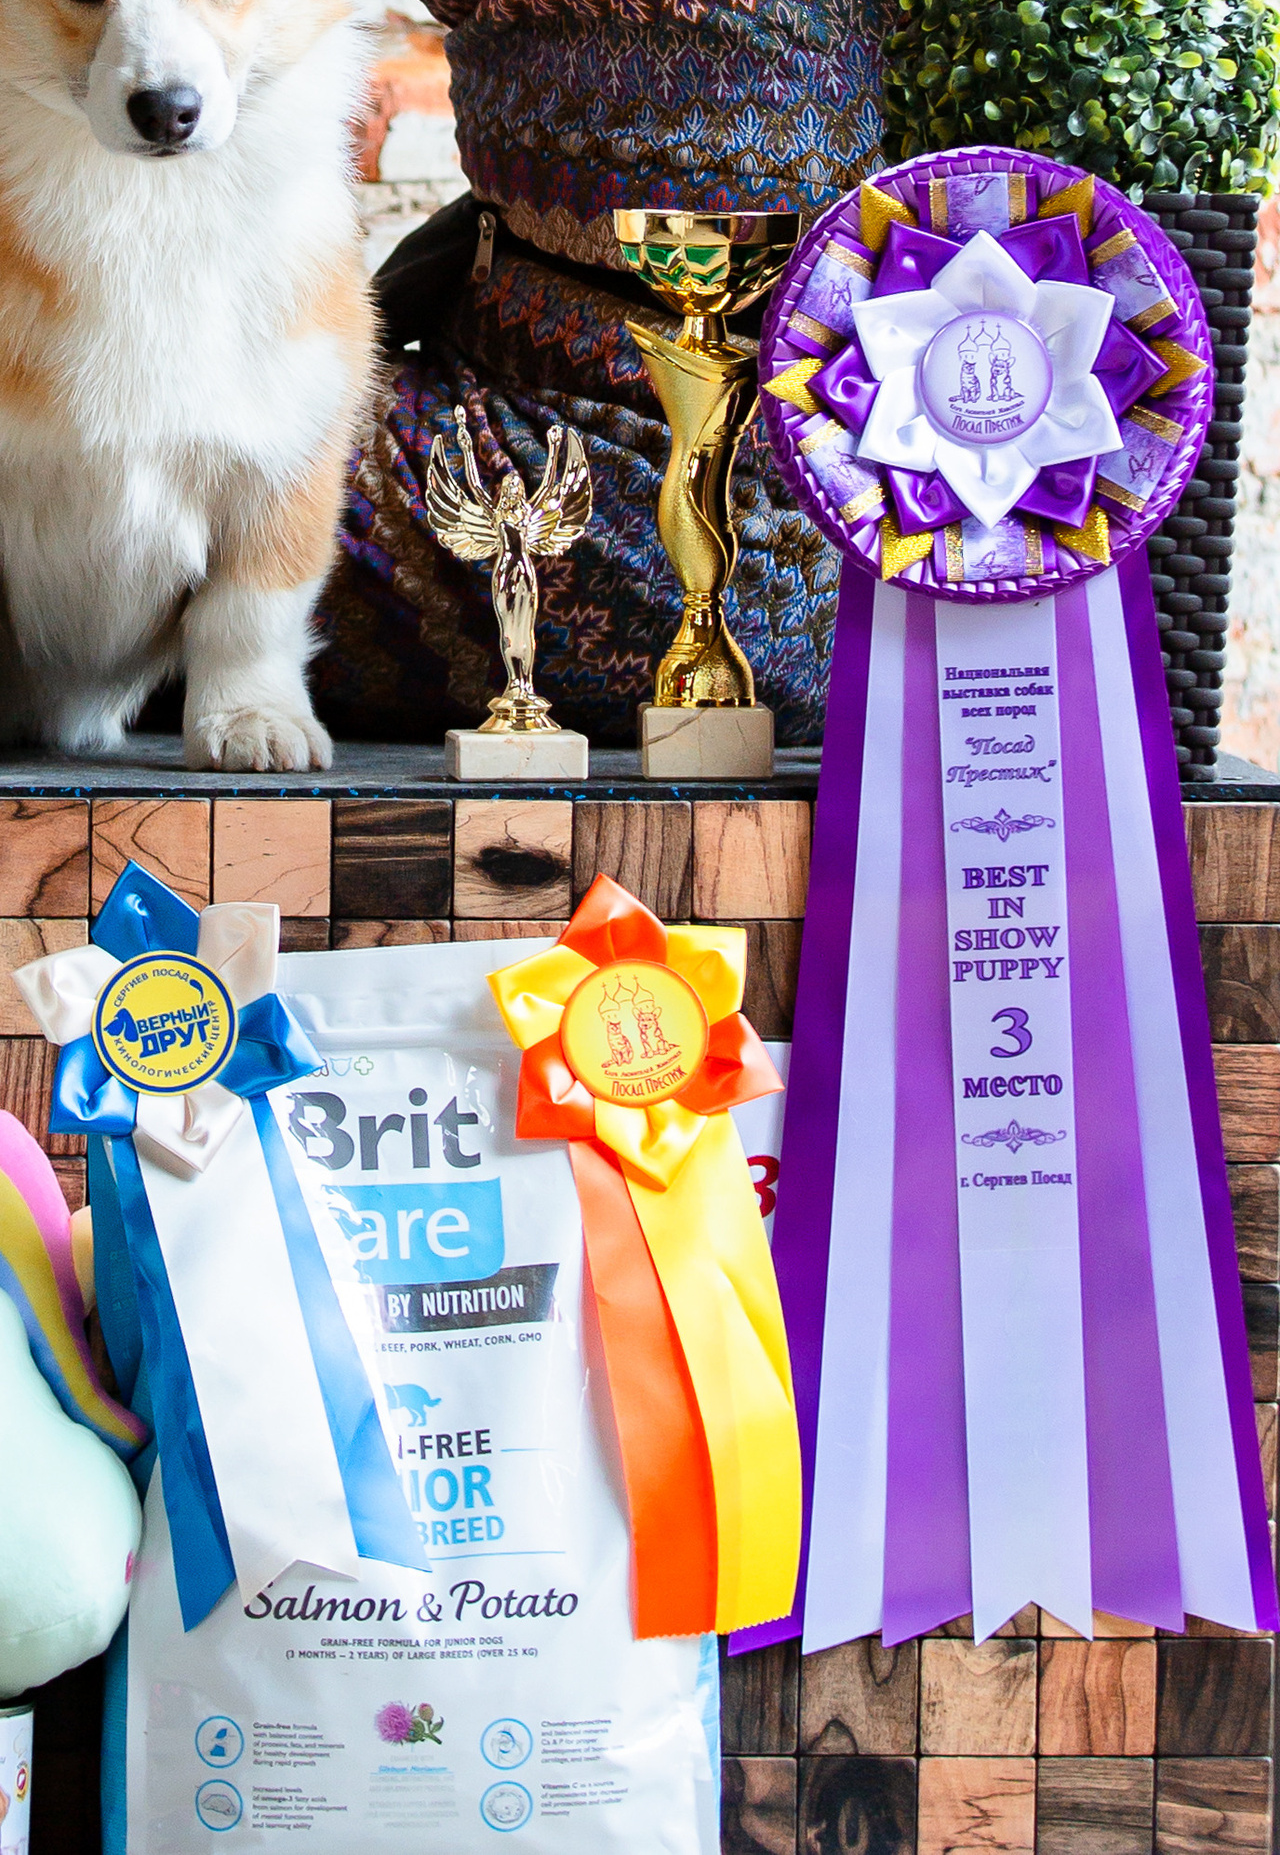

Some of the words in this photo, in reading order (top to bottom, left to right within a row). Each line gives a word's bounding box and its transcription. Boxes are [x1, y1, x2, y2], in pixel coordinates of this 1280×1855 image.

[945, 666, 1050, 681] Национальная
[942, 687, 1010, 699] выставка
[1014, 682, 1054, 696] собак
[961, 707, 992, 717] всех
[995, 705, 1037, 719] пород
[962, 864, 1049, 889] BEST
[987, 897, 1026, 919] IN
[954, 926, 1061, 951] SHOW
[953, 957, 1065, 982] PUPPY
[114, 973, 149, 1007] СЕРГИЕВ
[152, 969, 190, 982] ПОСАД
[114, 1038, 215, 1078] КИНОЛОГИЧЕСКИЙ
[208, 1000, 220, 1041] ЦЕНТР
[139, 1019, 210, 1059] ДРУГ
[990, 1007, 1033, 1058] 3
[962, 1074, 1063, 1098] место
[287, 1087, 482, 1171] Brit
[972, 1173, 1028, 1190] Сергиев
[1031, 1171, 1072, 1185] Посад
[351, 1207, 471, 1261] are
[387, 1293, 411, 1318] BY
[422, 1283, 525, 1318] NUTRITION
[410, 1342, 441, 1352] PORK,
[443, 1338, 482, 1350] WHEAT,
[484, 1334, 516, 1346] CORN,
[518, 1332, 542, 1342] GMO
[398, 1428, 492, 1460] -FREE
[243, 1581, 408, 1622] Salmon
[416, 1592, 443, 1622] &
[449, 1580, 579, 1621] Potato
[298, 1650, 337, 1659] MONTHS
[348, 1651, 354, 1659] 2
[357, 1650, 388, 1660] YEARS)
[392, 1651, 404, 1659] OF
[407, 1651, 436, 1659] LARGE
[439, 1650, 473, 1659] BREEDS
[476, 1649, 503, 1659] (OVER
[507, 1648, 519, 1657] 25
[320, 1638, 374, 1648] GRAIN-FREE
[377, 1638, 420, 1648] FORMULA
[424, 1638, 441, 1647] FOR
[444, 1637, 475, 1649] JUNIOR
[478, 1636, 503, 1645] DOGS
